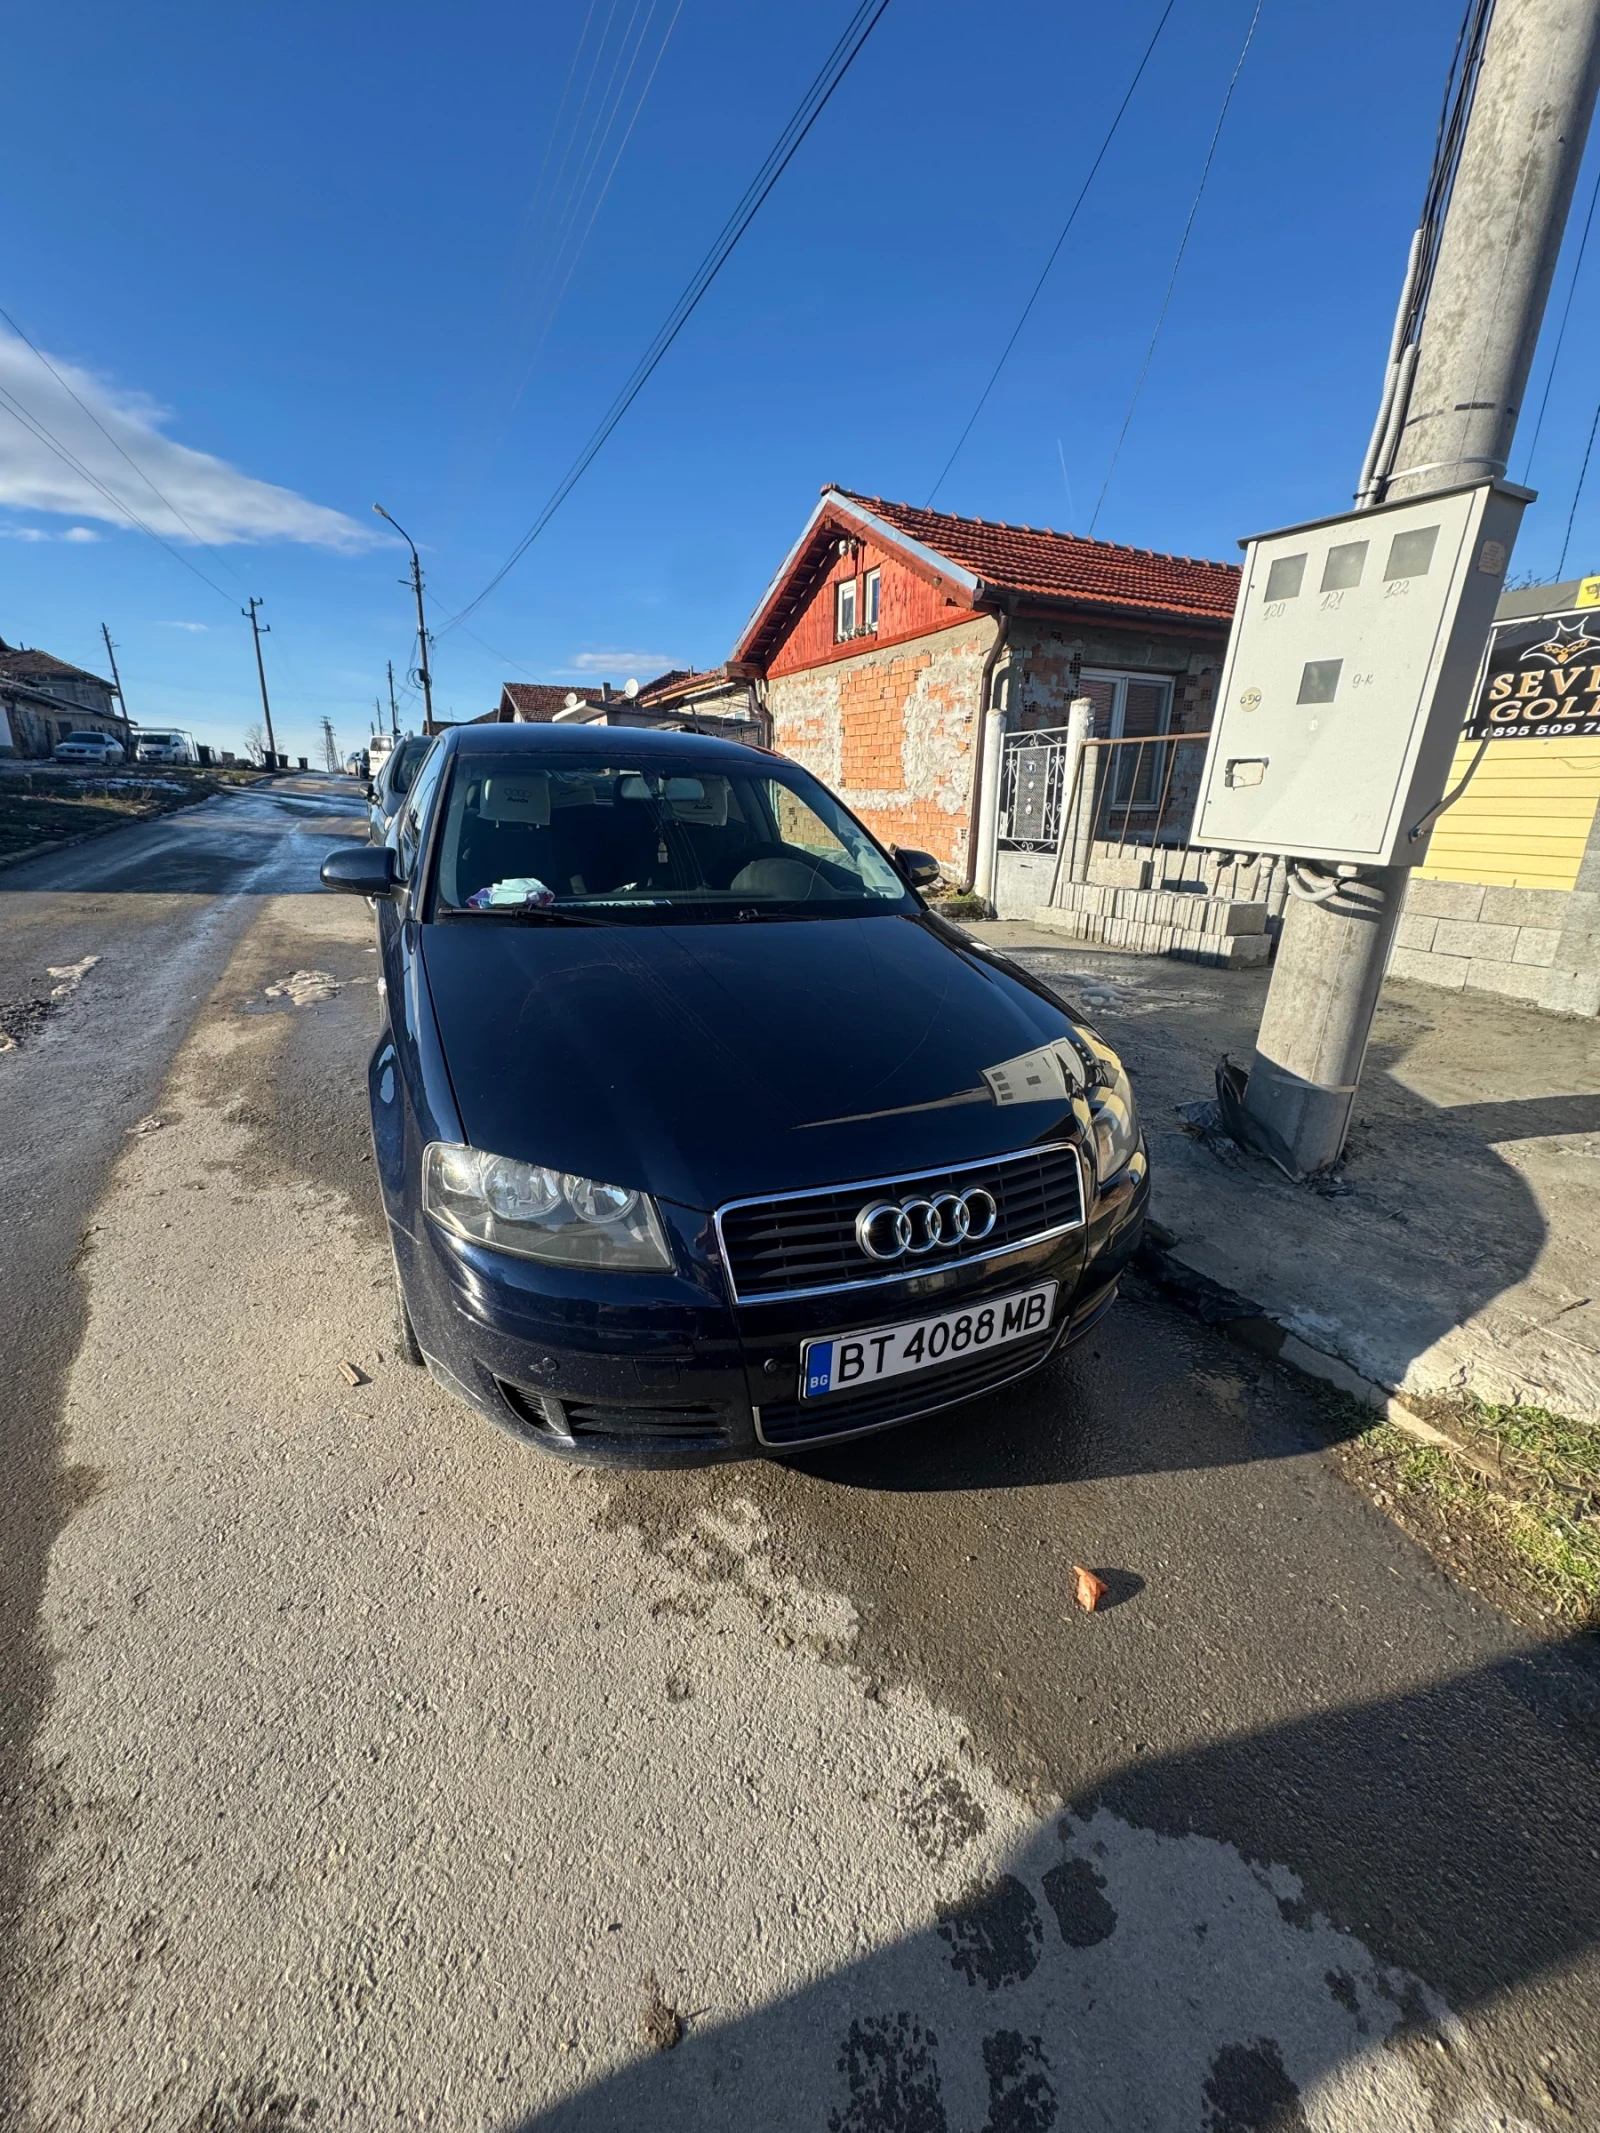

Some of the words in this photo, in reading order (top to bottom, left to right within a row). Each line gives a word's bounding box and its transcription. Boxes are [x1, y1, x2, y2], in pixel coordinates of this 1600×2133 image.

[1384, 580, 1410, 599] 122
[1320, 591, 1345, 611] 121
[1263, 602, 1286, 621] 120
[1536, 723, 1576, 735] 509
[1583, 722, 1600, 733] 7
[838, 1334, 895, 1383] BT
[903, 1309, 995, 1363] 4088
[1001, 1293, 1046, 1338] MB
[810, 1374, 829, 1389] BG
